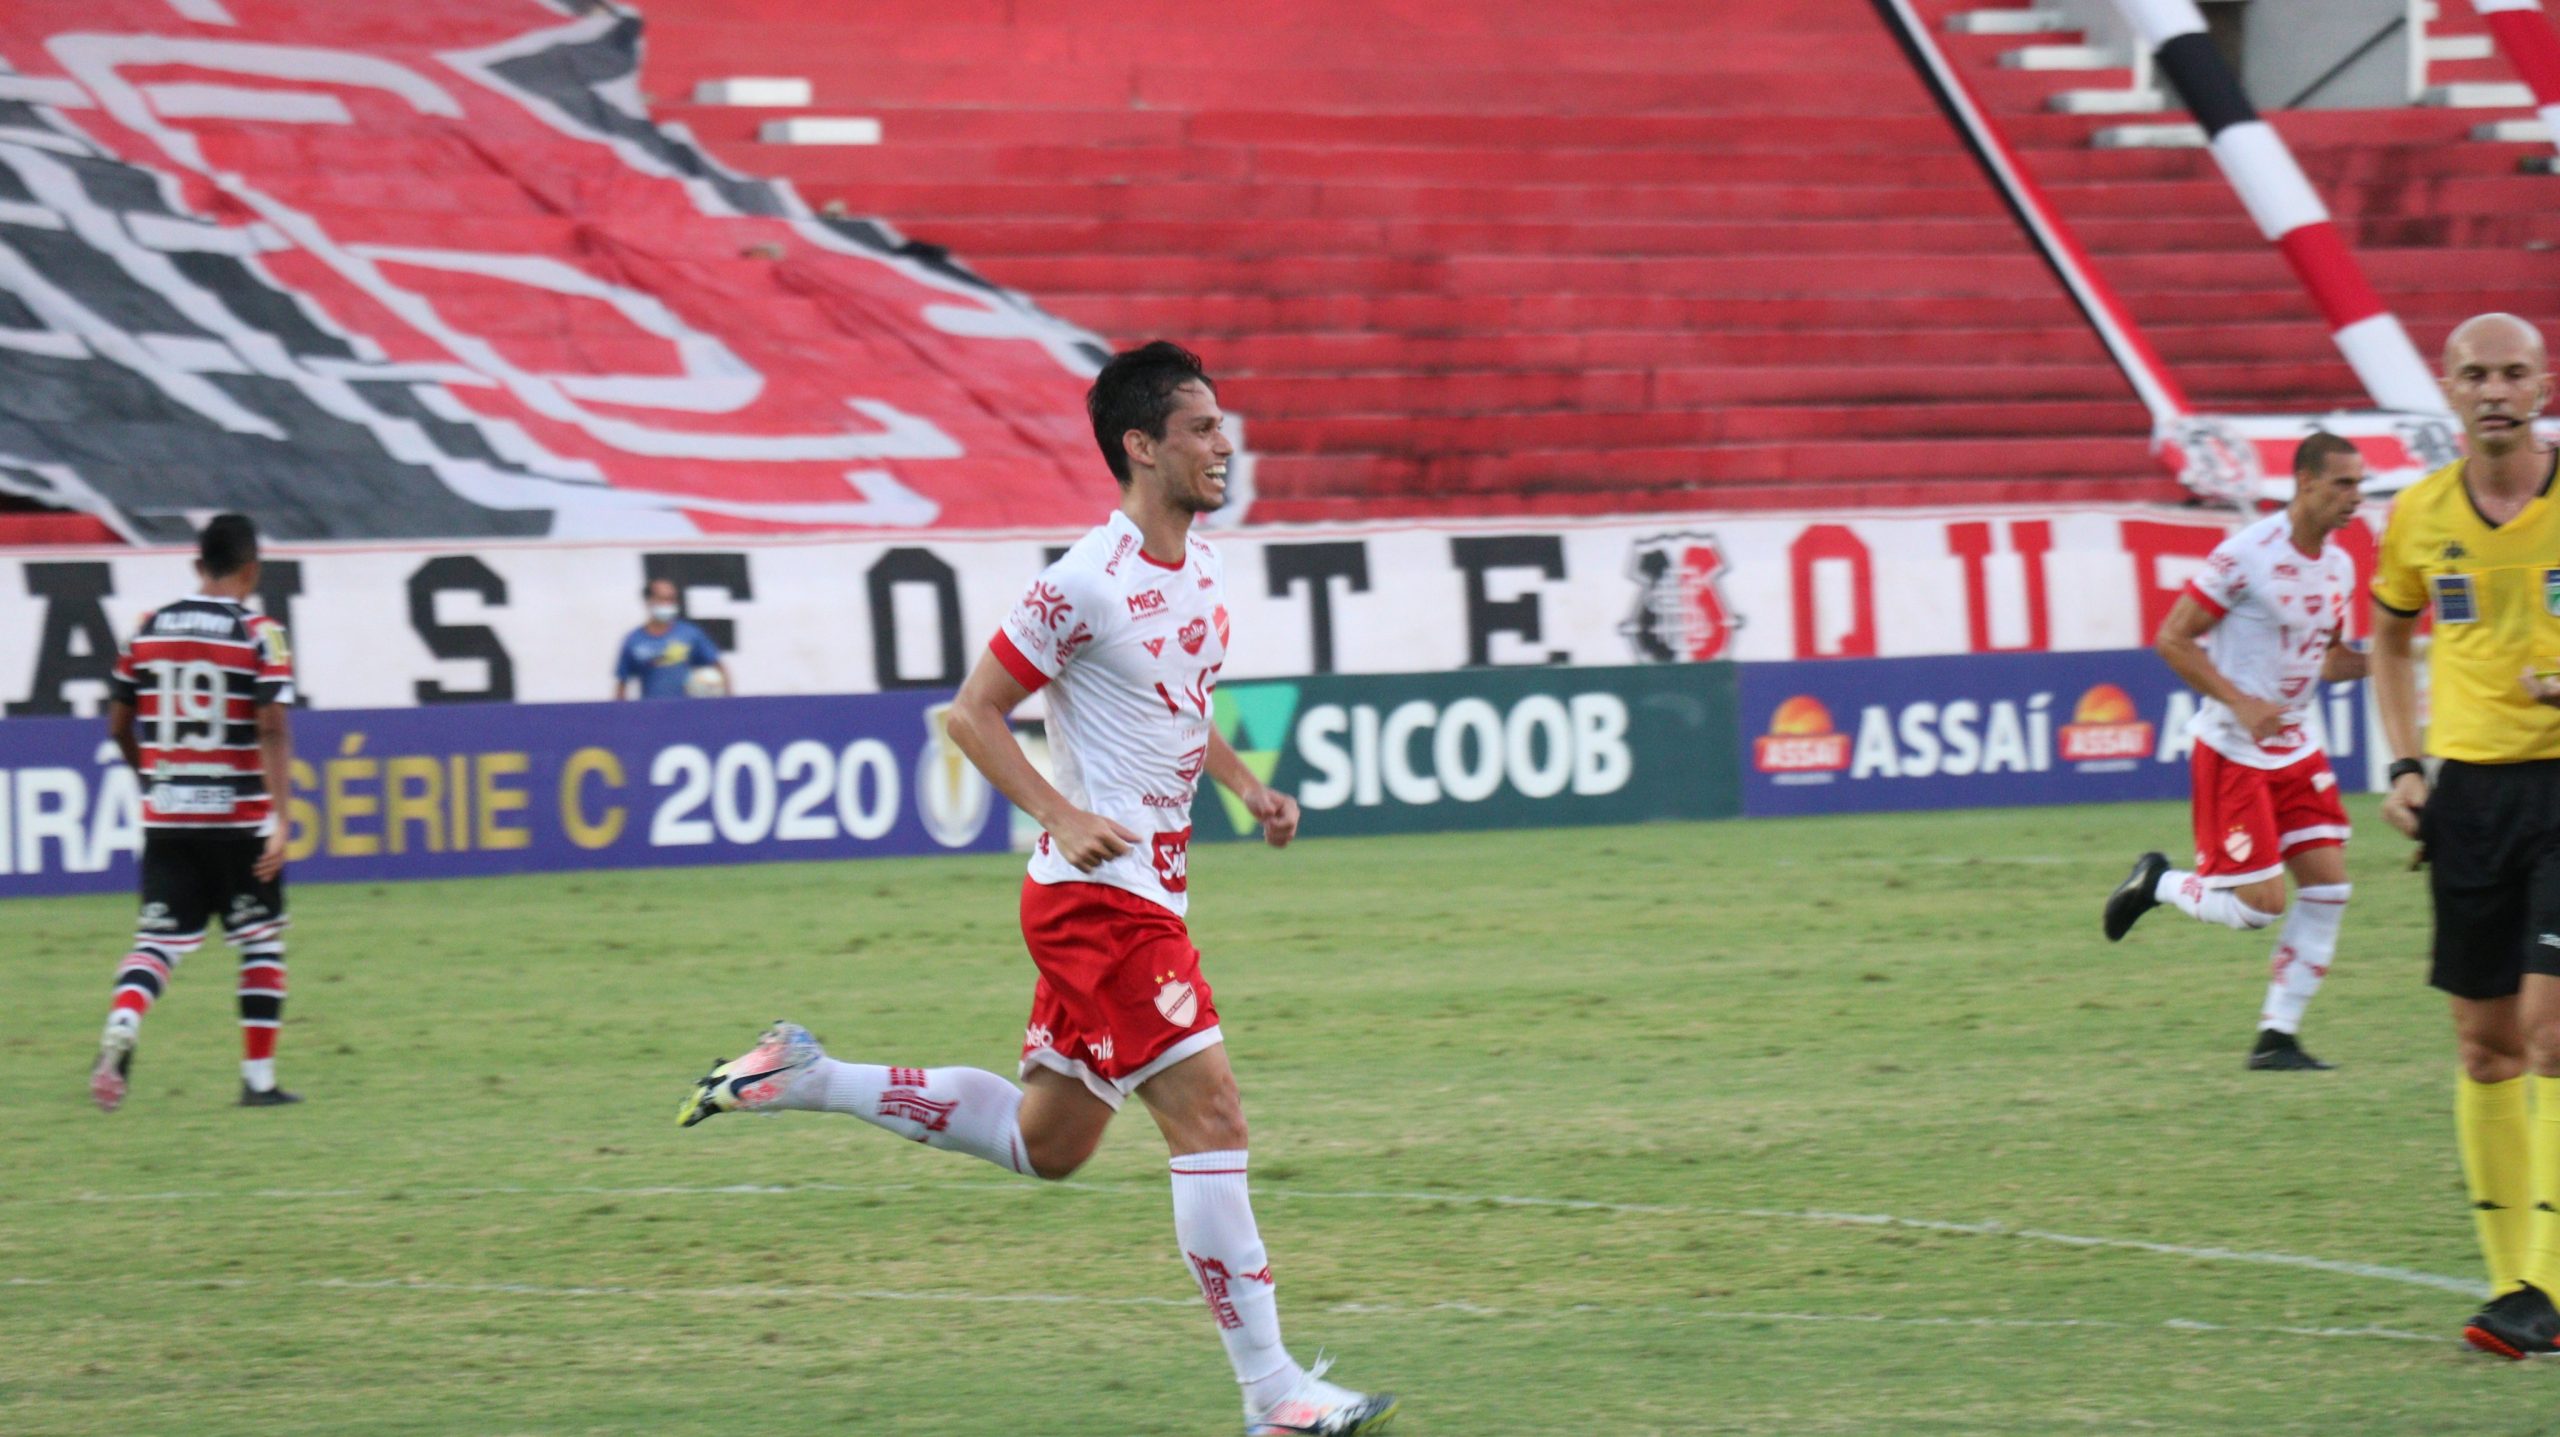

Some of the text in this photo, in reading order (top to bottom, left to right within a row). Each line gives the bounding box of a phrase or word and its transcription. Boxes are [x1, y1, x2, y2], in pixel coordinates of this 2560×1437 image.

[1126, 588, 1166, 613] MEGA
[150, 659, 227, 750] 19
[1295, 691, 1633, 810] SICOOB
[285, 732, 532, 862] SÉRIE
[560, 746, 627, 850] C
[649, 737, 900, 847] 2020
